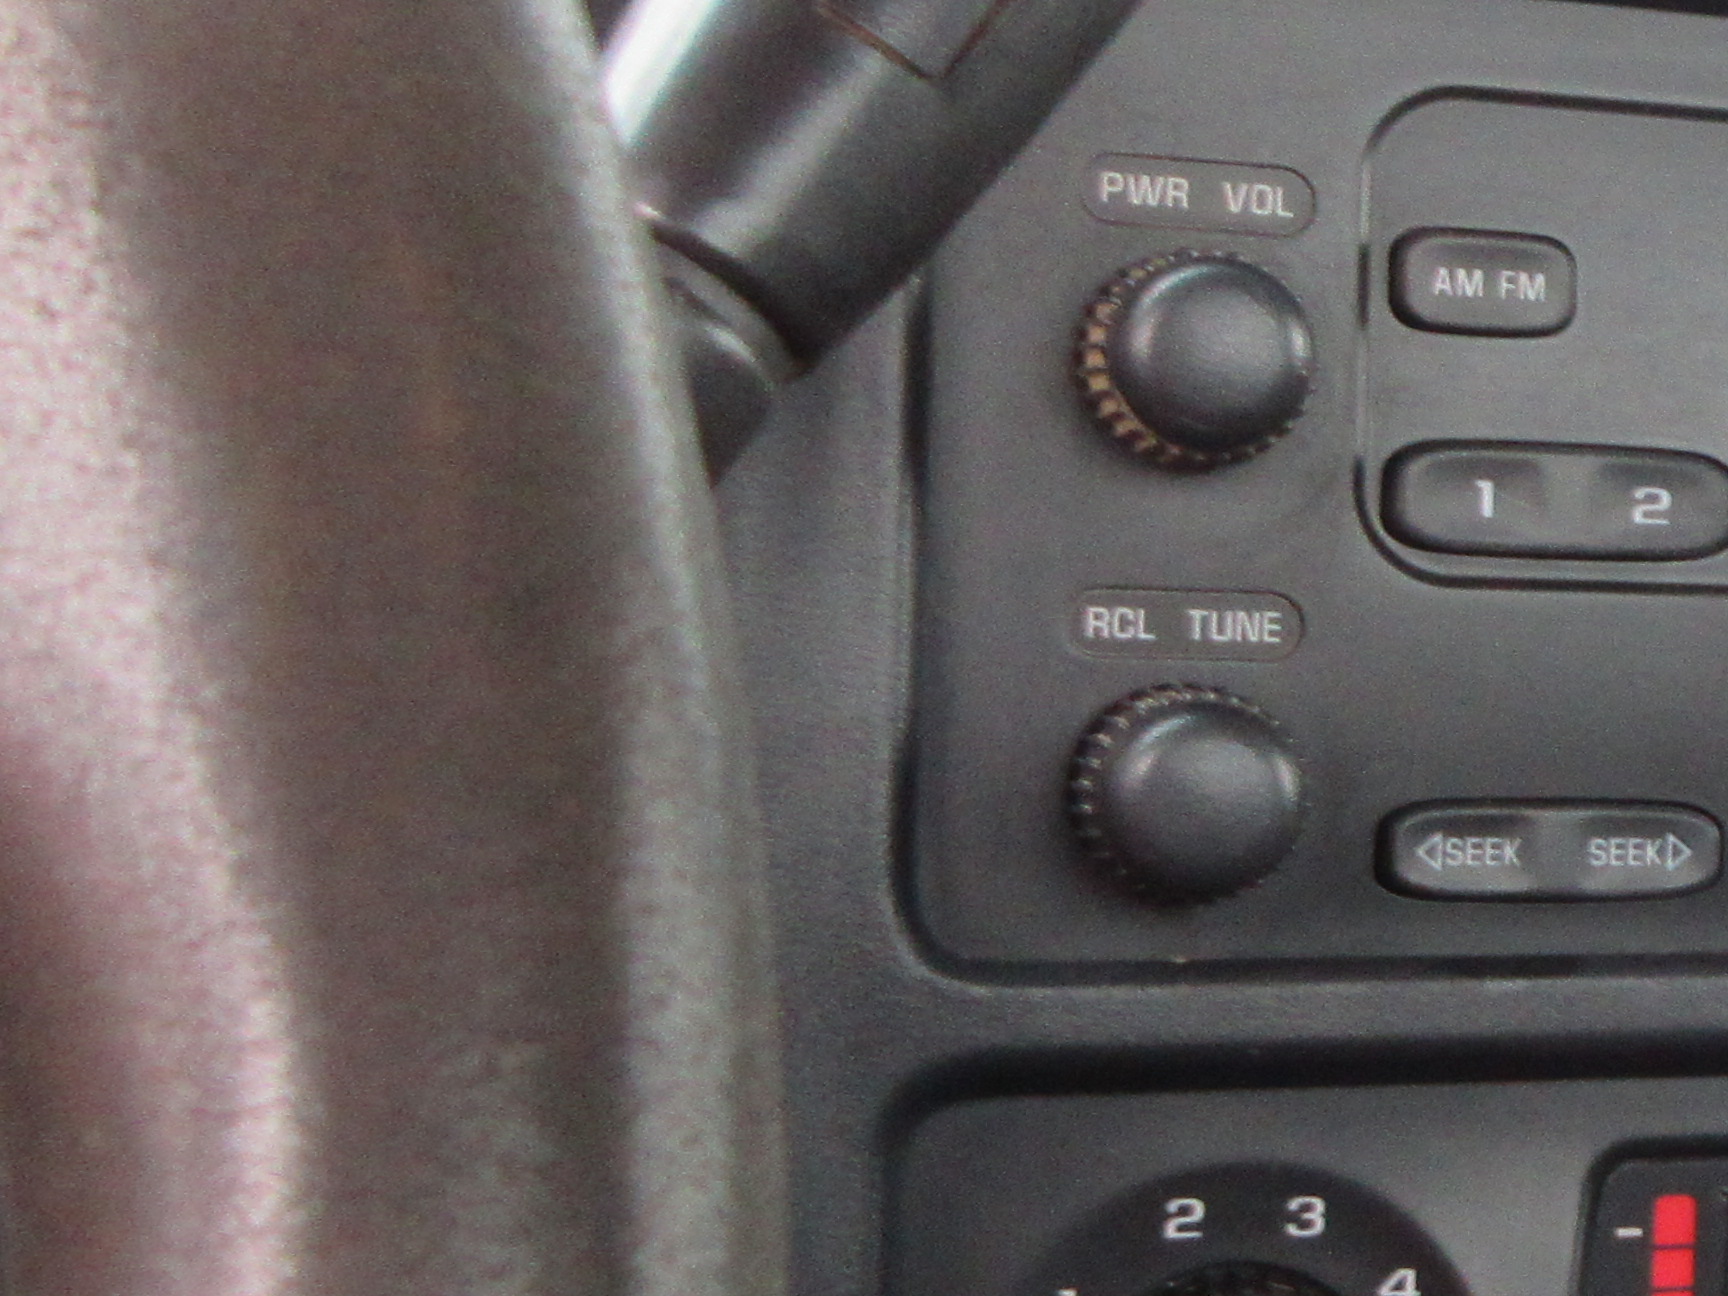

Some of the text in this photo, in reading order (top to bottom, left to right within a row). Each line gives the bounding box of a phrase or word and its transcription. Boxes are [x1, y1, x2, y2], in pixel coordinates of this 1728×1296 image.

[1100, 170, 1294, 219] PWR VOL
[1432, 266, 1547, 302] AM FM
[1474, 479, 1672, 526] 1 2
[1085, 605, 1281, 644] RCL TUNE
[1444, 837, 1518, 868] SEEK
[1589, 838, 1662, 868] SEEK
[1163, 1197, 1206, 1241] 2
[1284, 1195, 1326, 1238] 3
